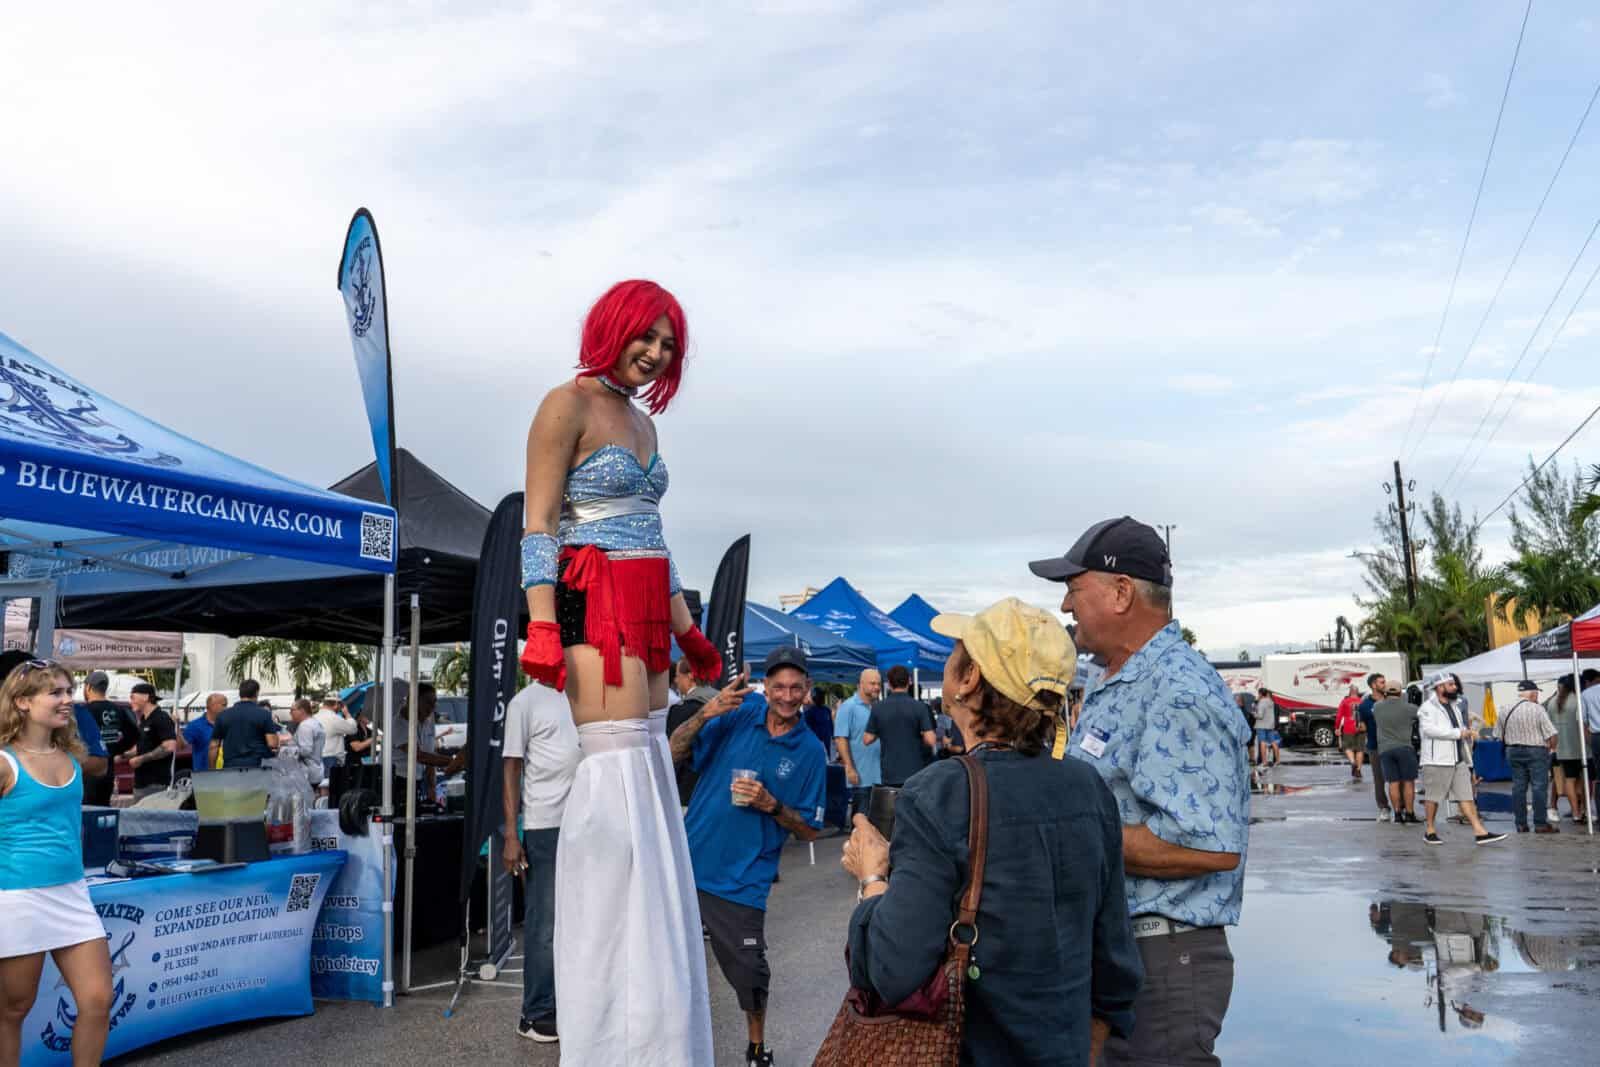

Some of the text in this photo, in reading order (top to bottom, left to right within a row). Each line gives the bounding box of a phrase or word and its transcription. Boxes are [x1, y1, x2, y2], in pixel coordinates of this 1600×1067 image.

[17, 461, 343, 539] BLUEWATERCANVAS.COM
[1104, 554, 1117, 568] VI
[80, 643, 102, 651] HIGH
[105, 644, 143, 653] PROTEIN
[94, 903, 145, 925] WATER
[155, 893, 272, 923] COME SEE OUR NEW
[154, 906, 280, 937] EXPANDED LOCATION!
[1143, 921, 1160, 931] CUP
[184, 944, 200, 955] SW
[200, 940, 219, 951] 2ND
[219, 937, 236, 948] AVE
[238, 933, 258, 944] FORT
[328, 925, 362, 941] Tops
